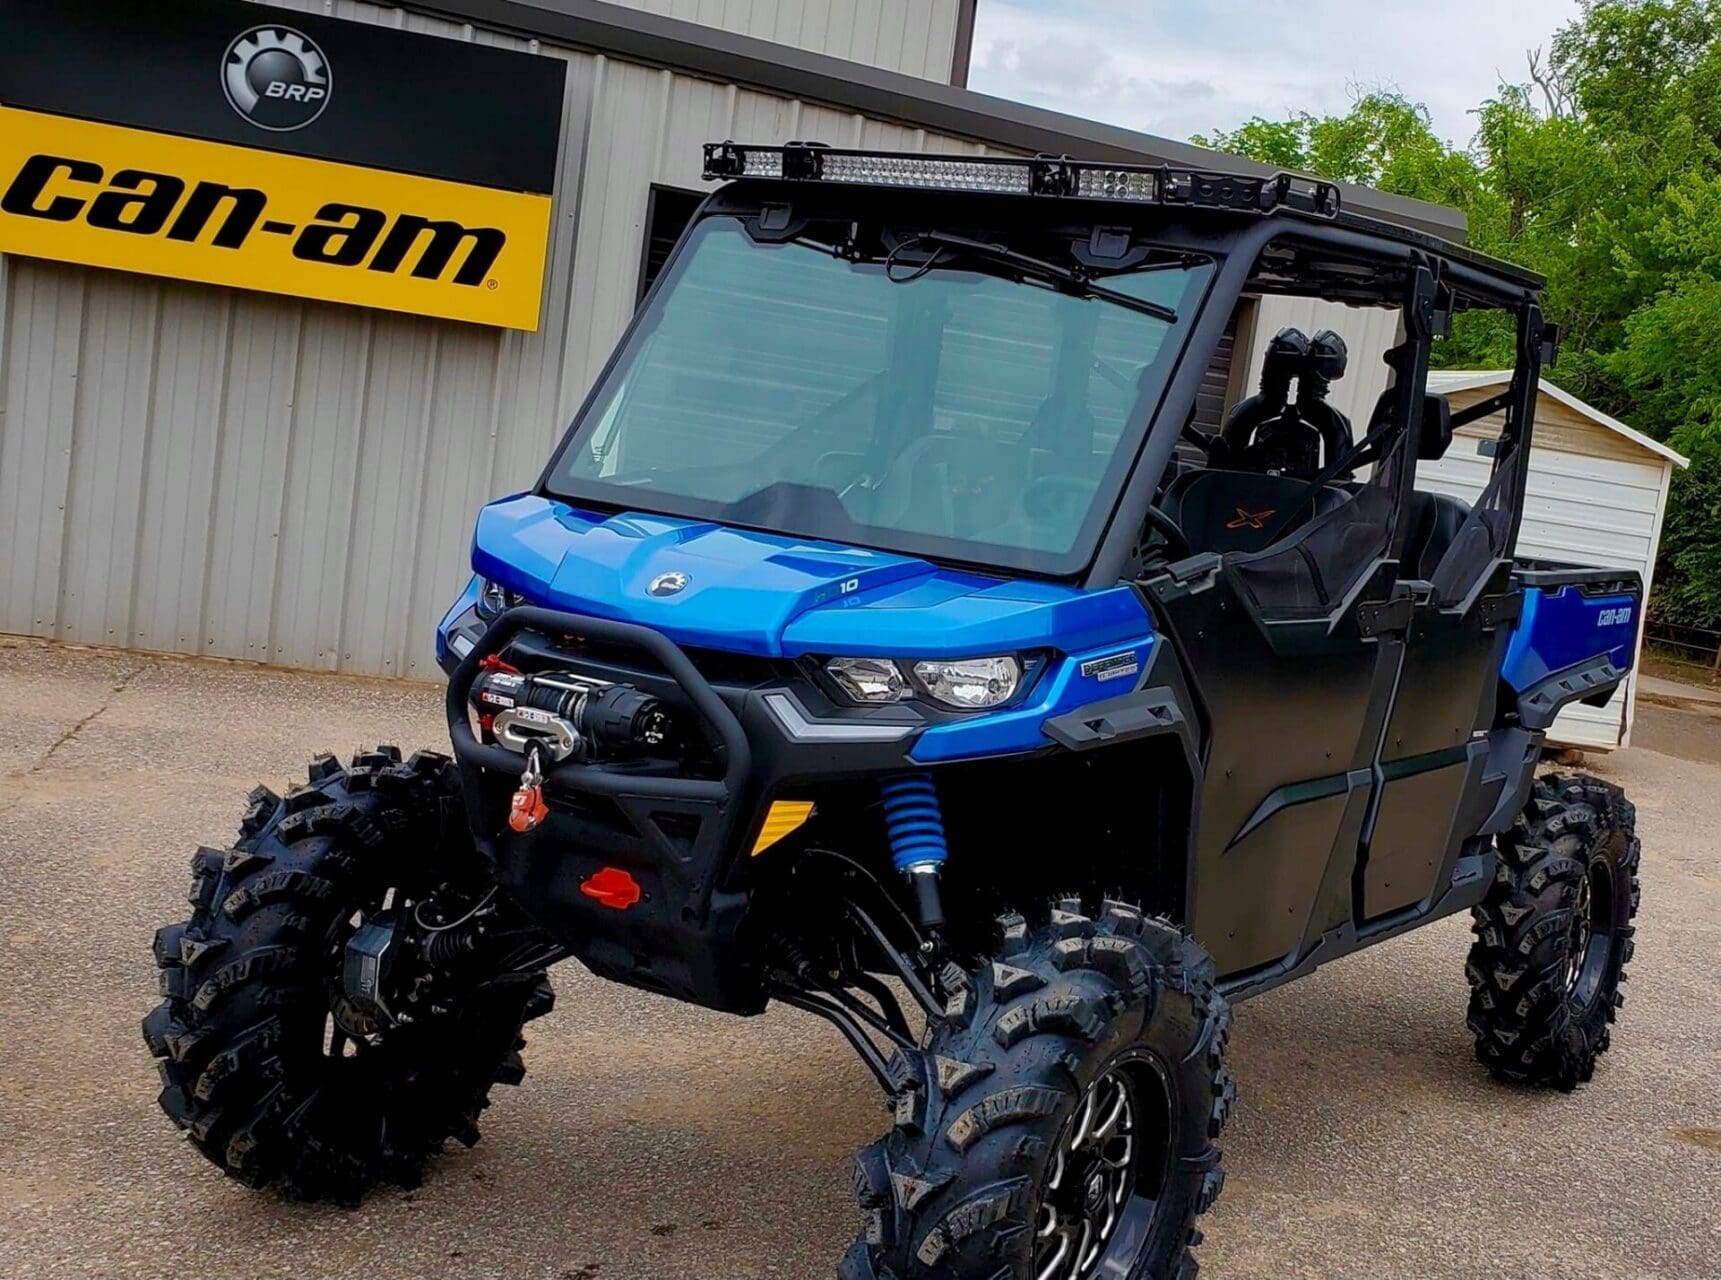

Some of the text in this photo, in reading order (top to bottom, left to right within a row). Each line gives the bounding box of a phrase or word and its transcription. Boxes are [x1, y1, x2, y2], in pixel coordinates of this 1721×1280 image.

[265, 81, 325, 102] BRP
[1, 154, 506, 287] can-am
[1597, 607, 1632, 626] can-am
